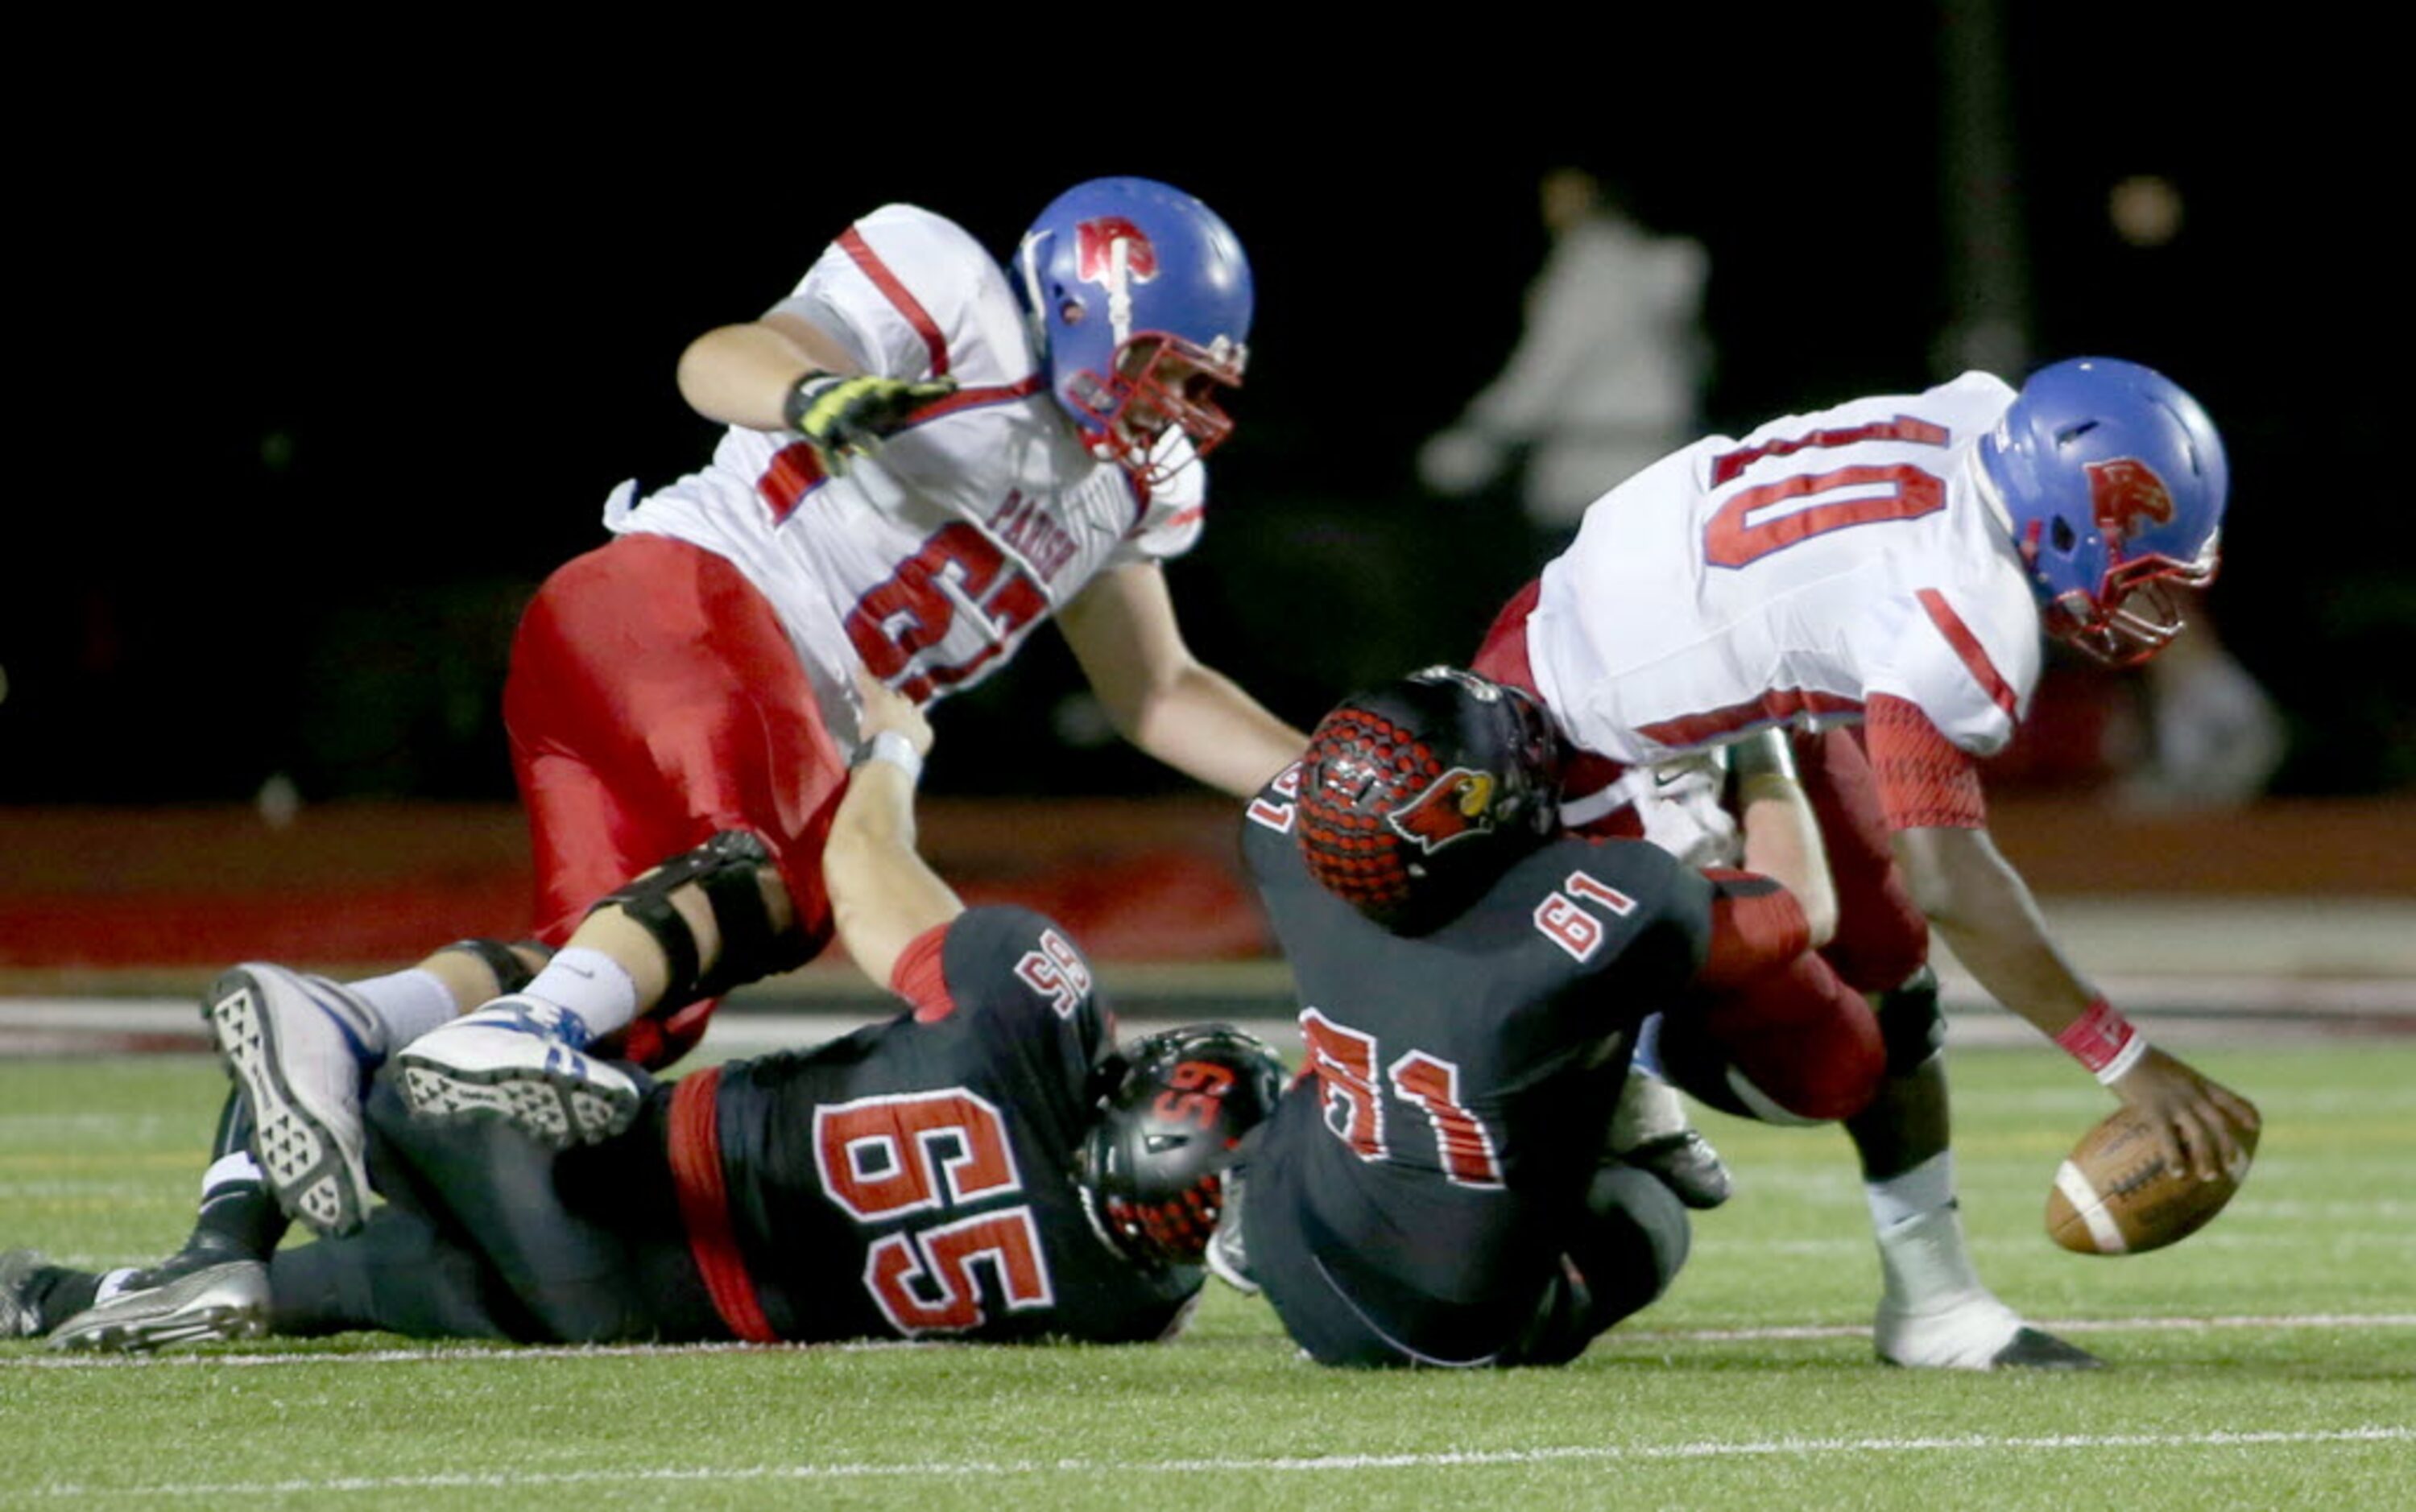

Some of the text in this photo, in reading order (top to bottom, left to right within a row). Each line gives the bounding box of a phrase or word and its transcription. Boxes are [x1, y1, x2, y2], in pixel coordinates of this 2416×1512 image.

[1702, 414, 1950, 569] 10
[844, 519, 1049, 706] 67
[1014, 927, 1091, 1020] 65
[1533, 870, 1636, 962] 61
[1152, 1060, 1235, 1130] 65
[813, 1087, 1054, 1337] 65
